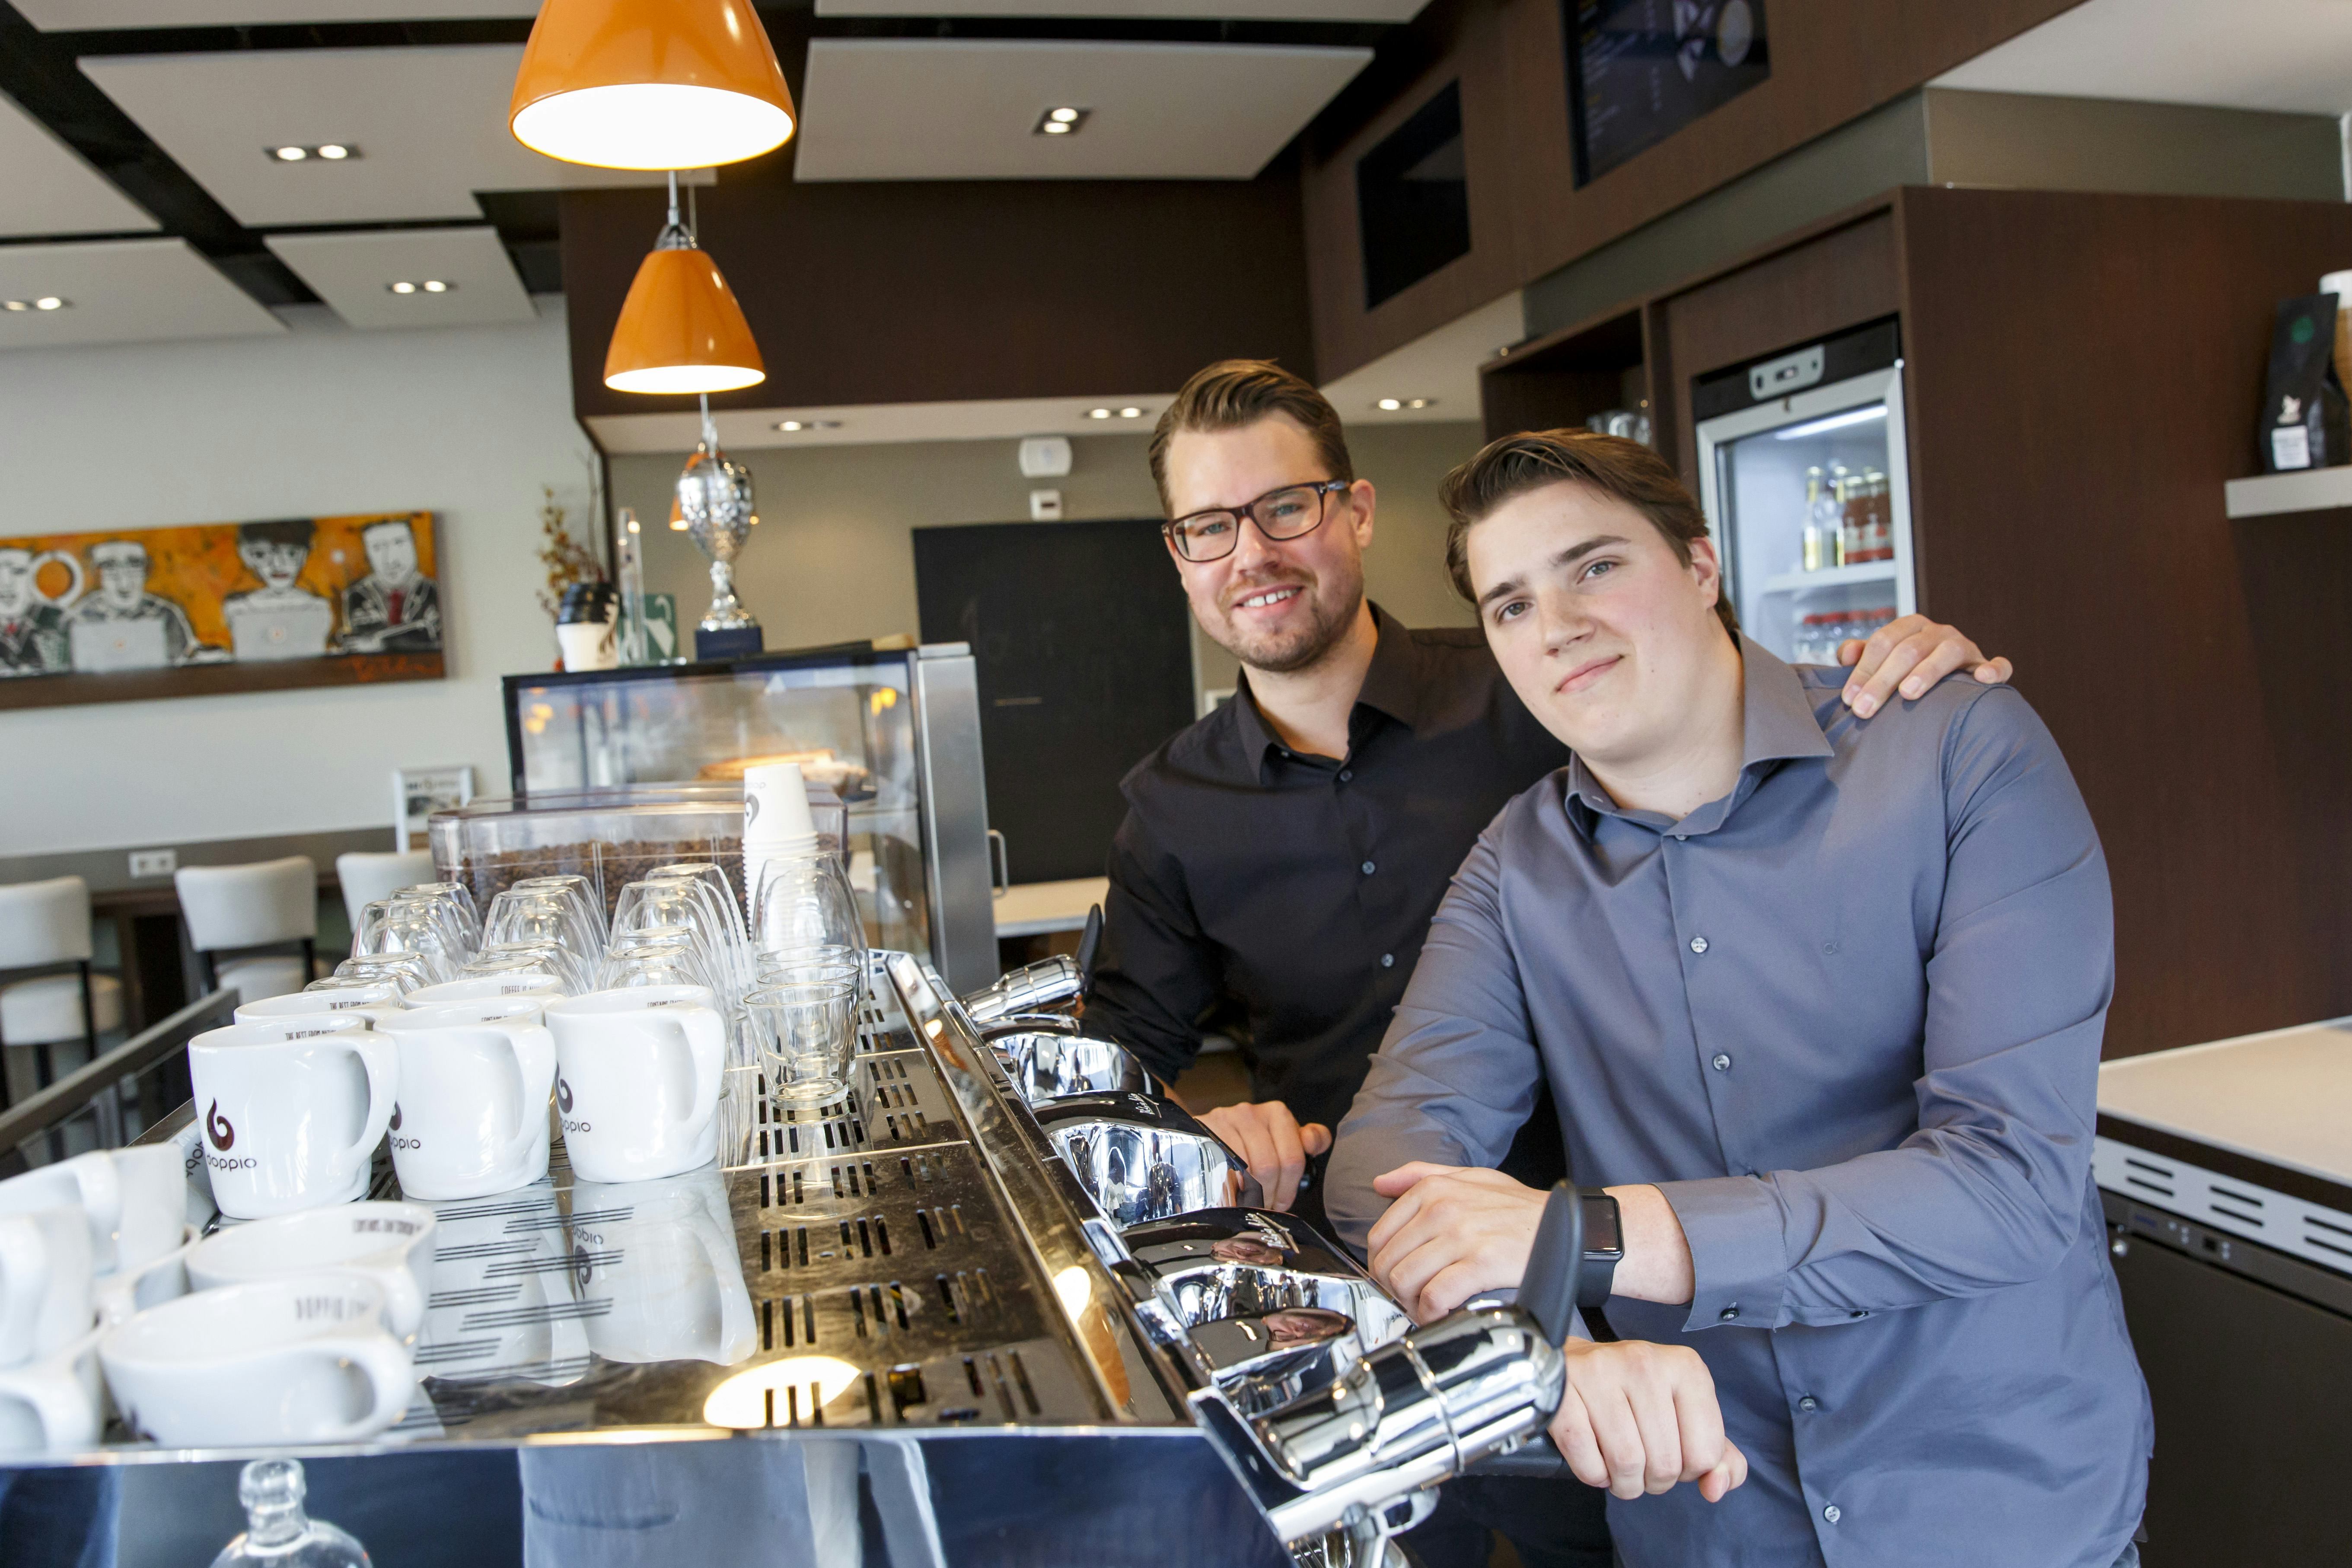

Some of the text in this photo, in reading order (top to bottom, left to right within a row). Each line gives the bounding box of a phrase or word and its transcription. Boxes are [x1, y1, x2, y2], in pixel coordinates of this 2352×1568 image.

[285, 1032, 294, 1041] THE
[296, 1031, 307, 1039] BEST
[207, 1153, 257, 1172] doppio
